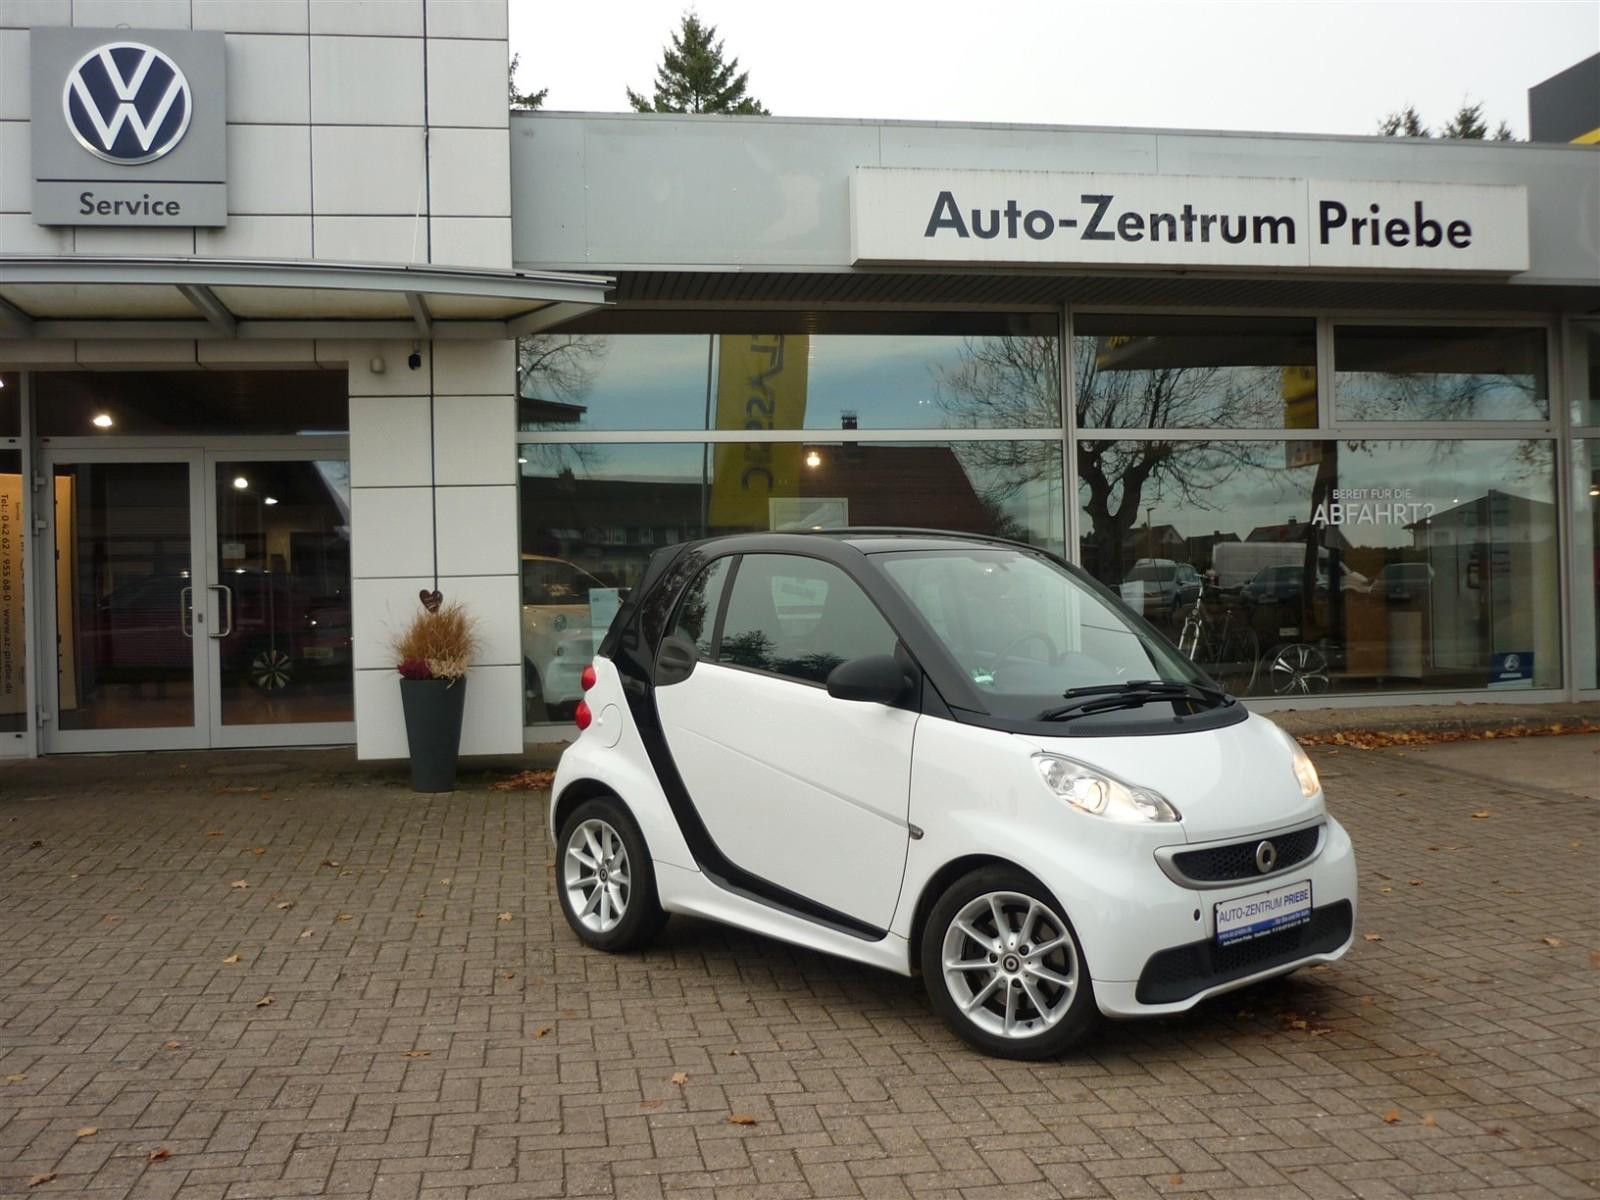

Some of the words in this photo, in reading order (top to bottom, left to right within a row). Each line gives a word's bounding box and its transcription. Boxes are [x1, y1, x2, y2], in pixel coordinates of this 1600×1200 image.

[79, 192, 181, 216] Service
[923, 191, 1296, 245] Auto-Zentrum
[1319, 200, 1472, 249] Priebe
[1332, 488, 1369, 500] BEREIT
[1370, 486, 1393, 500] FÜR
[1394, 488, 1412, 500] DIE
[1311, 503, 1437, 526] ABFAHRT?
[2, 537, 10, 550] 62
[2, 558, 11, 577] 955
[1219, 897, 1283, 923] AUTO-ZENTRUM
[1283, 888, 1309, 907] PRIEBE
